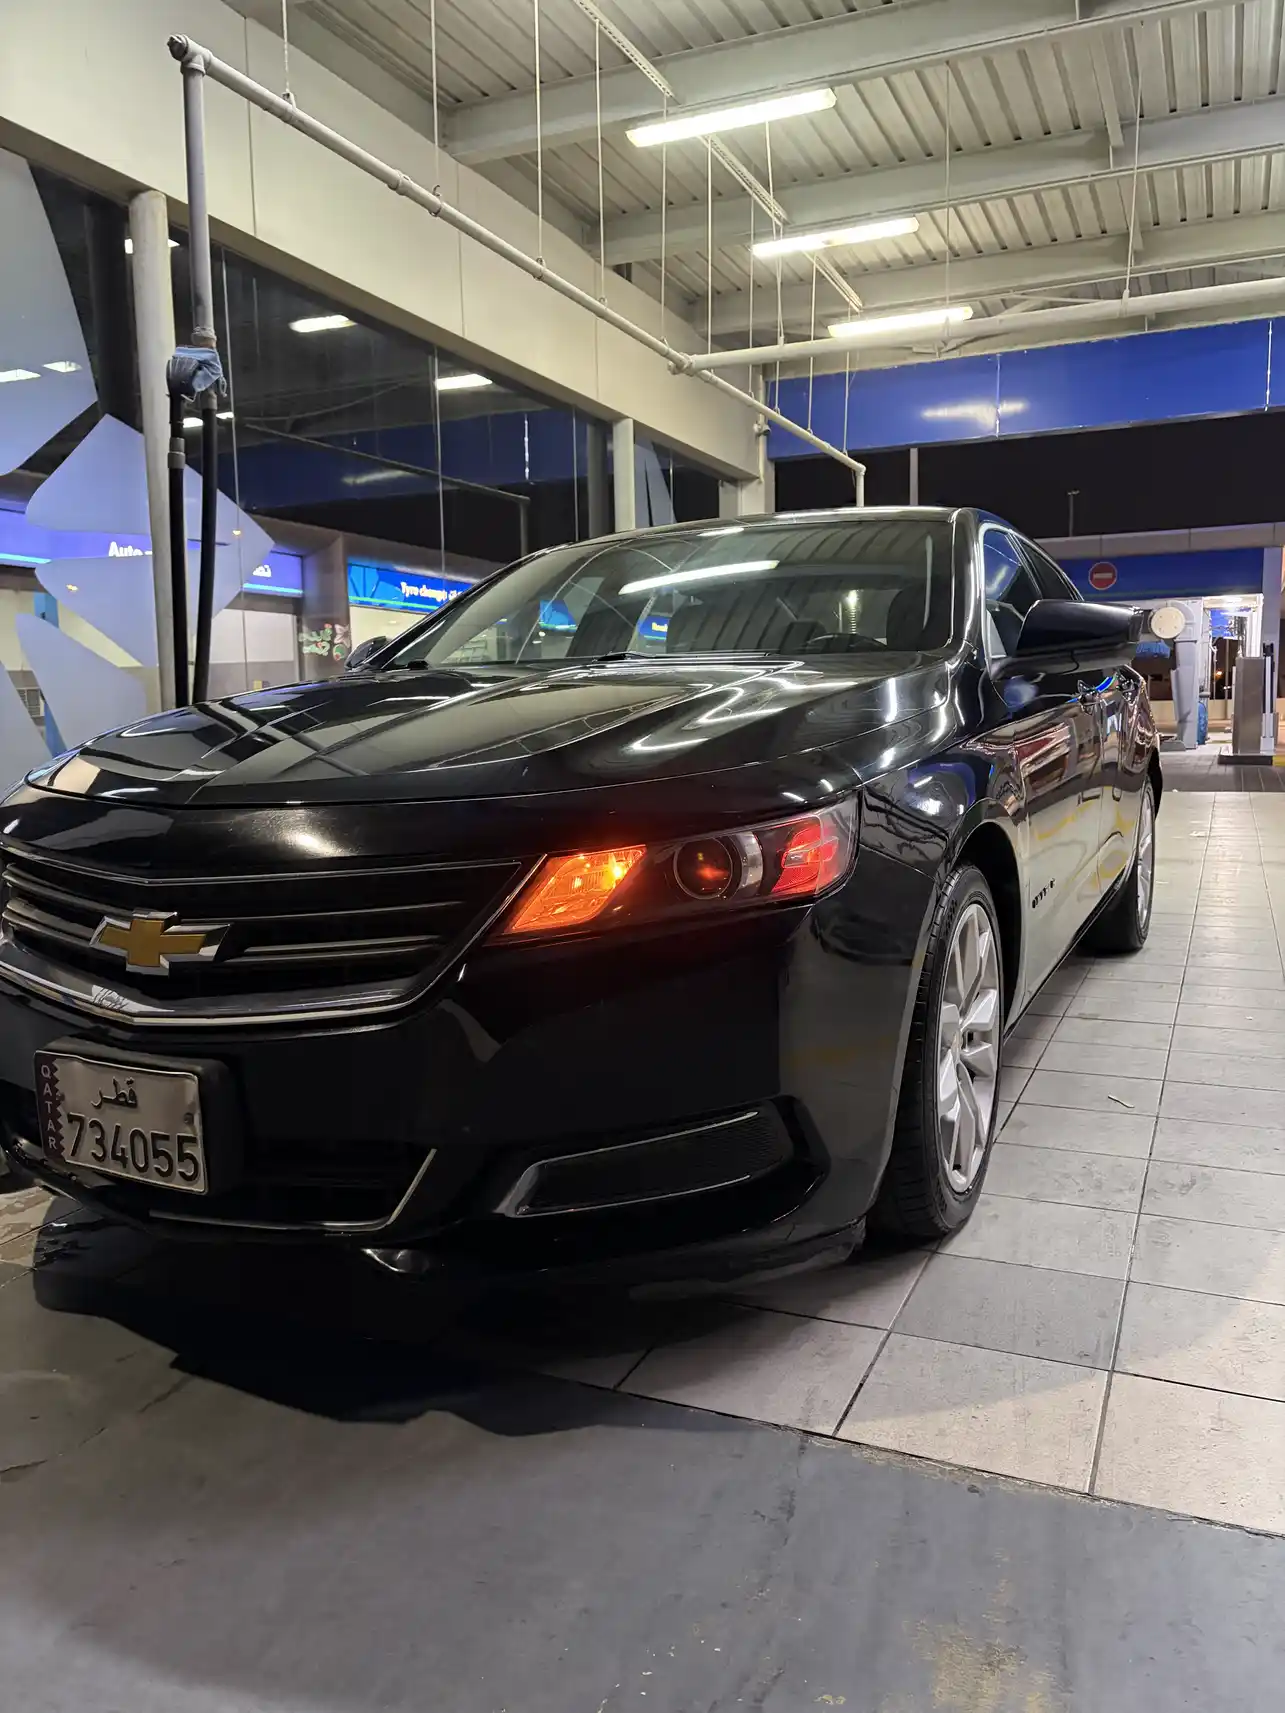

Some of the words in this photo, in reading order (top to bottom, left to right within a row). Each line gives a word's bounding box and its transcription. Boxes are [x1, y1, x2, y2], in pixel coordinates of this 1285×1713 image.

[40, 1064, 58, 1150] QATAR
[90, 1076, 138, 1109] قطر
[67, 1112, 199, 1182] 734055
